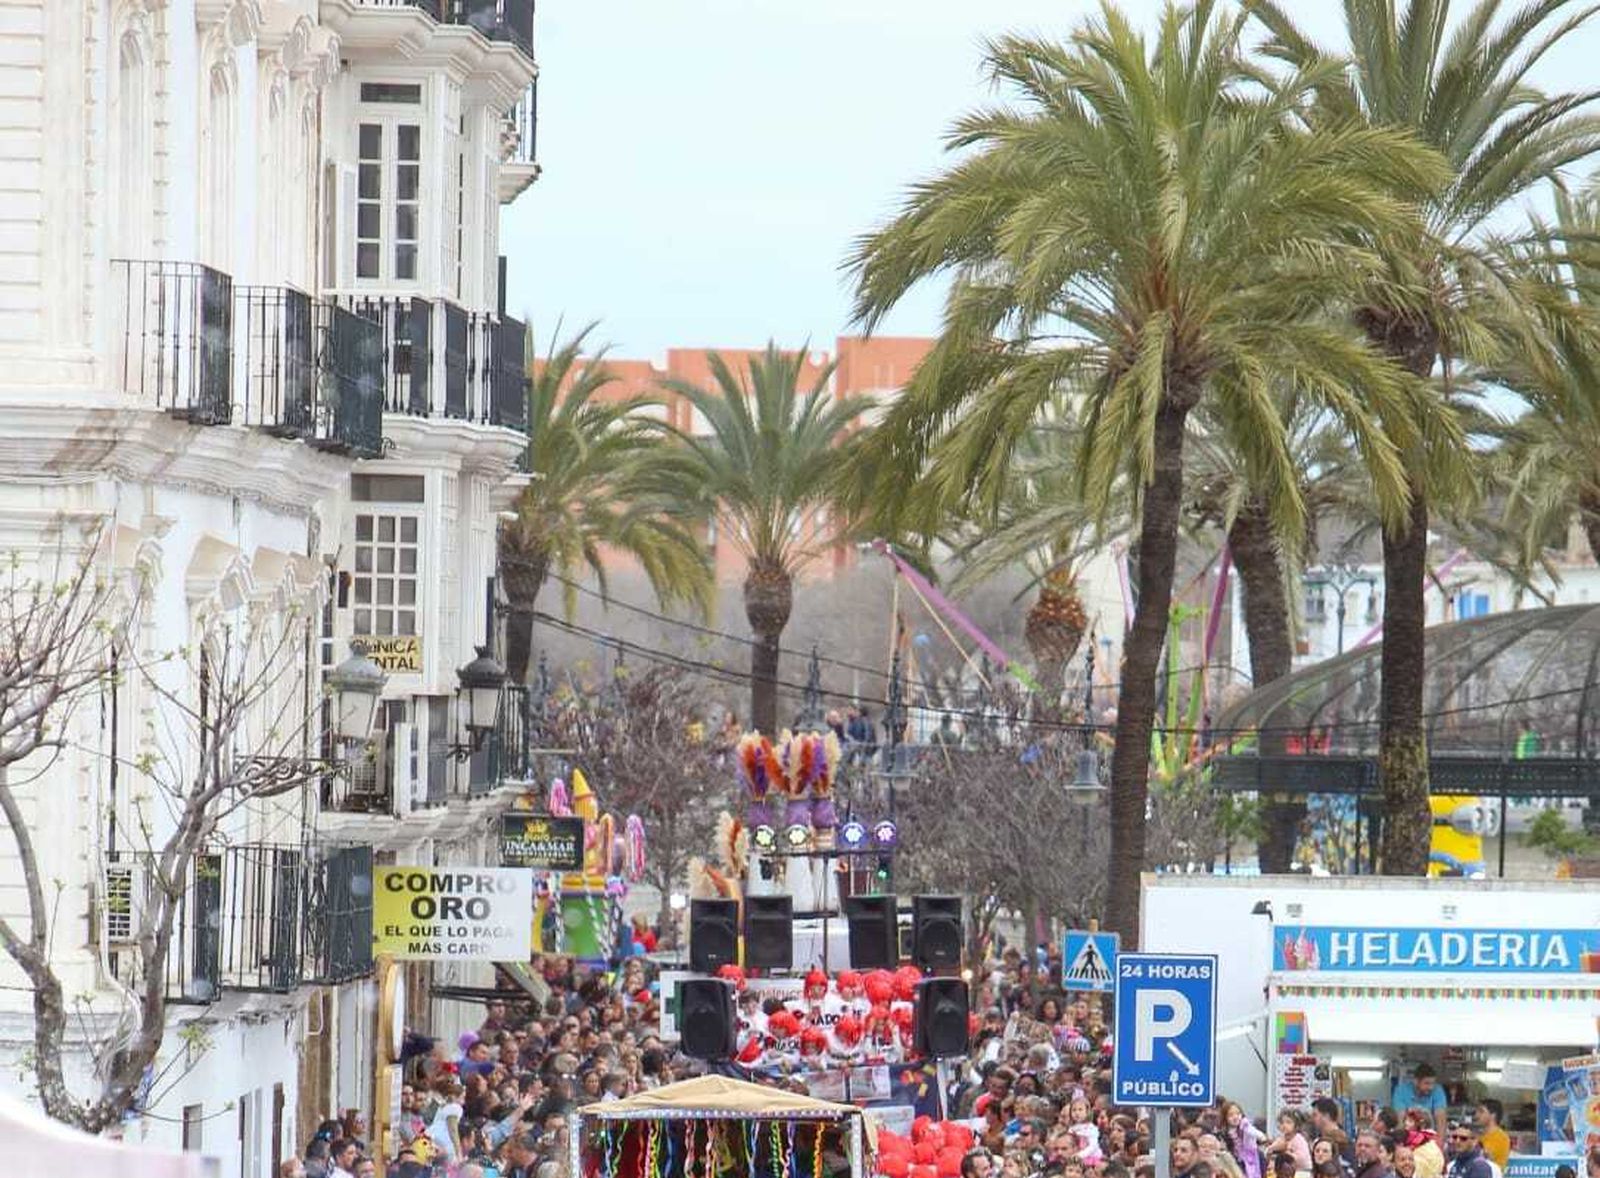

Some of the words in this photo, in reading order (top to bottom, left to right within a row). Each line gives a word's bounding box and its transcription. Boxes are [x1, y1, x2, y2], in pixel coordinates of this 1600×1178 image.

[385, 872, 516, 893] COMPRO
[411, 896, 491, 920] ORO
[385, 925, 404, 937] EL
[409, 926, 442, 937] QUE
[447, 926, 468, 938] LO
[472, 926, 514, 938] PAGA
[1330, 931, 1571, 968] HELADERIA
[1121, 964, 1143, 978] 24
[1149, 965, 1211, 979] HORAS
[1134, 989, 1193, 1062] P
[1122, 1078, 1204, 1096] PÚBLICO
